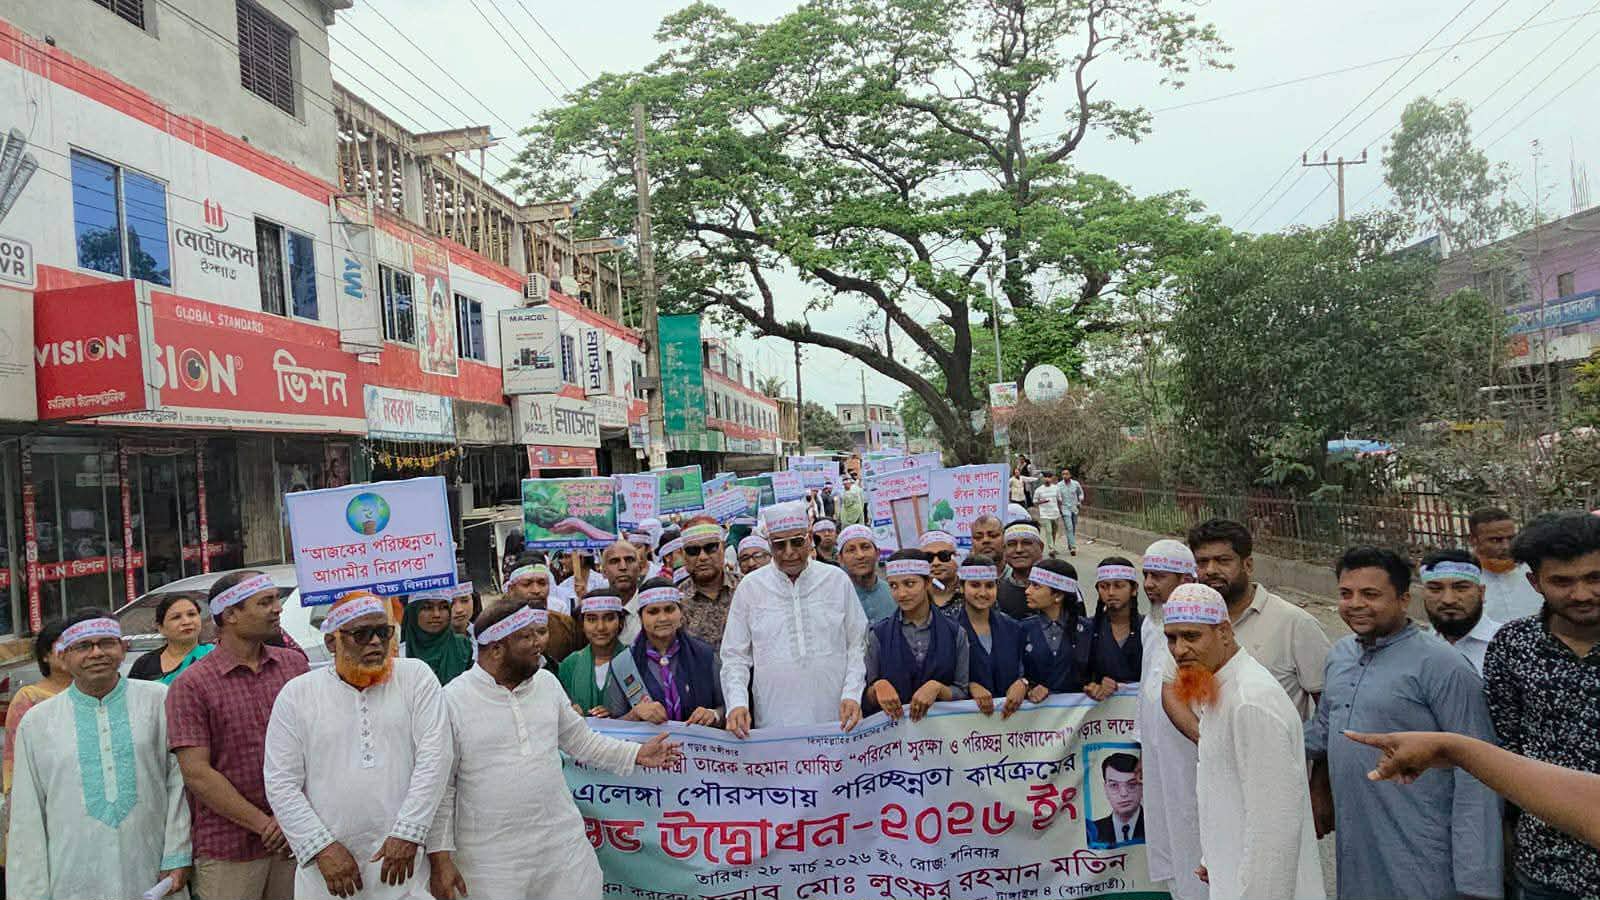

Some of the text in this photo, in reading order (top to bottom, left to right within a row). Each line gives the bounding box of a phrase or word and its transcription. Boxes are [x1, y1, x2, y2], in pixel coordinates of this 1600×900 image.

[176, 305, 264, 334] GLOBAL STANDARD
[273, 349, 348, 407] ভিশন
[312, 562, 369, 585] আগামীর
[573, 752, 1076, 808] এলেঙ্গা পৌরসভায় পরিচ্ছন্নতা কার্যক্রমের
[693, 757, 738, 773] তারেক
[744, 760, 788, 778] রহমান
[795, 754, 843, 776] ঘোষিত
[949, 740, 957, 754] ও
[1027, 783, 1079, 832] ইং
[758, 865, 782, 877] ২৮
[789, 859, 818, 874] মার্চ
[824, 852, 871, 868] ২০২৬
[950, 845, 1000, 863] শনিবার
[797, 875, 855, 900] মোঃ
[957, 862, 1042, 892] রহমান
[1050, 849, 1128, 877] মতিন
